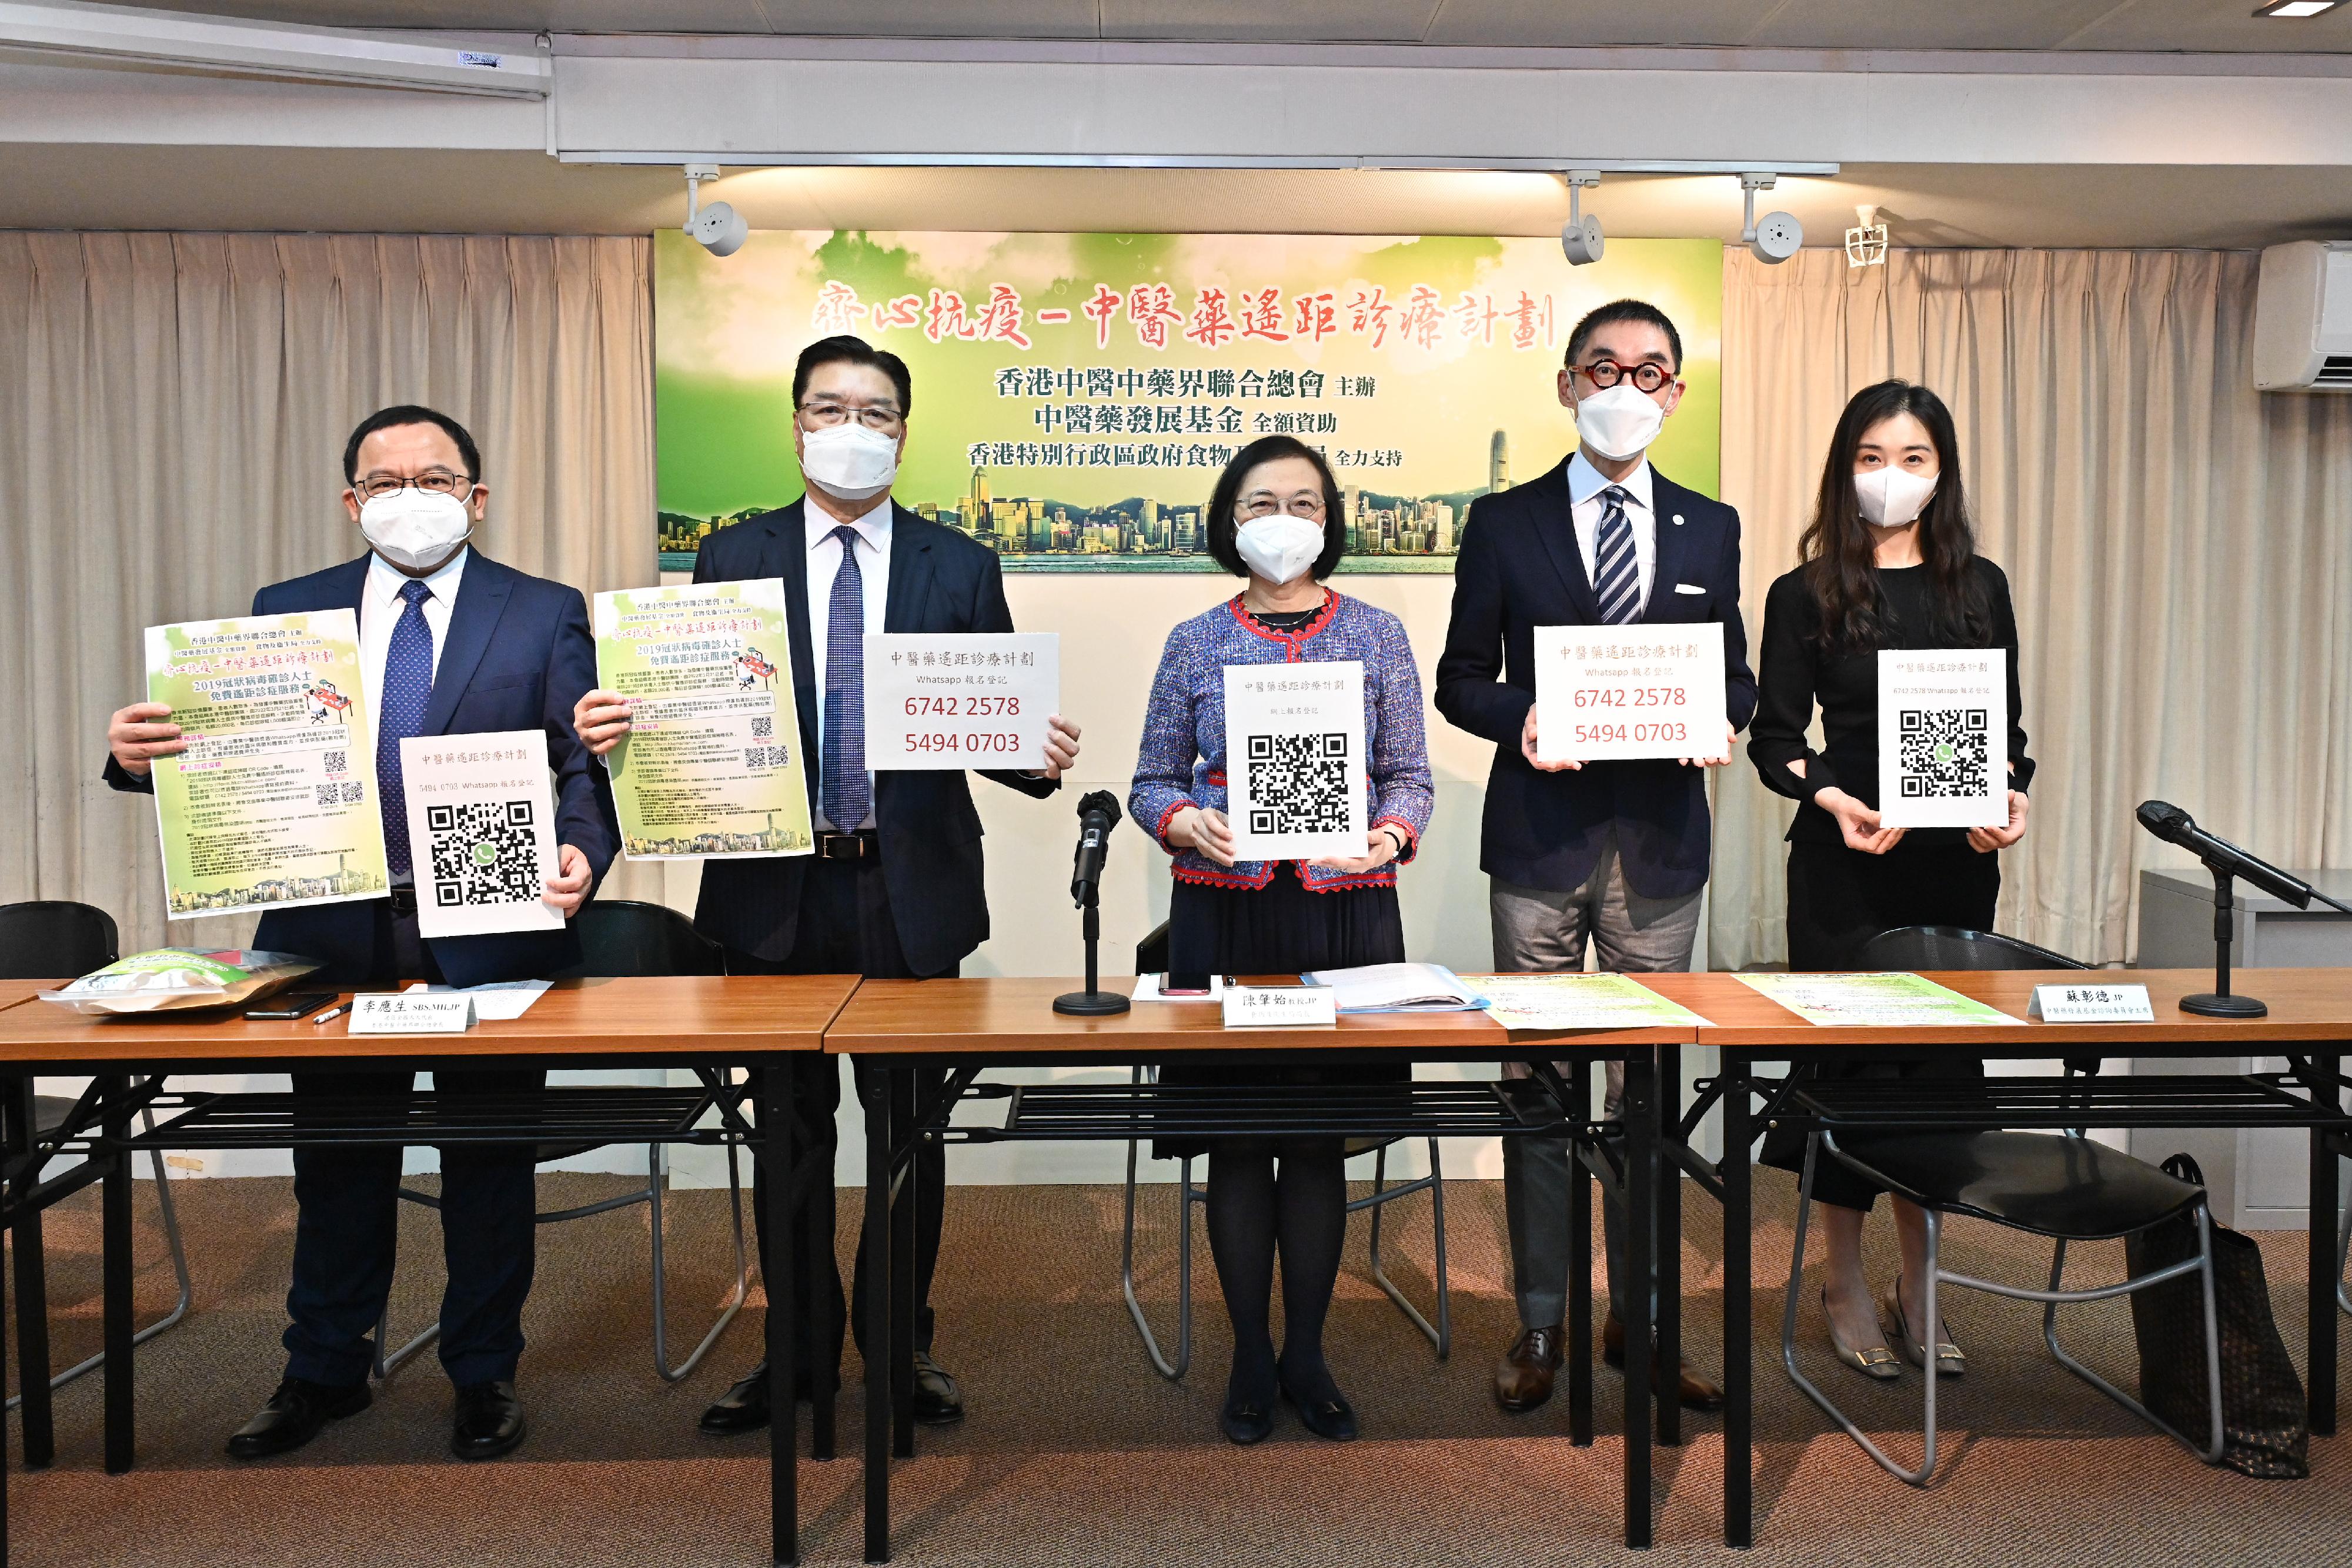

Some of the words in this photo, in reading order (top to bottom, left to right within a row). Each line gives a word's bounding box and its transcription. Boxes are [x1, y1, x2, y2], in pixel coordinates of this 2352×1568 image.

[995, 368, 1325, 398] 香港中醫中藥界聯合總會
[1334, 376, 1375, 397] 主辦
[1035, 406, 1243, 434] 中醫藥發展基金
[1252, 412, 1337, 433] 全額資助
[1335, 449, 1402, 467] 全力支持
[891, 651, 1034, 667] 中醫藥遙距診療計劃
[1561, 644, 1698, 660] 中醫藥遙距診療計劃
[916, 676, 961, 685] Whatsapp
[964, 675, 1007, 684] 報名登記
[1585, 668, 1628, 677] Whatsapp
[1631, 667, 1673, 676] 報名登記
[1244, 680, 1344, 693] 中醫藥遙距診療計劃
[1575, 690, 1626, 707] 6742
[1634, 688, 1686, 706] 2578
[905, 697, 958, 716] 6742
[966, 697, 1020, 716] 2578
[1575, 724, 1627, 743] 5494
[1635, 723, 1686, 741] 0703
[905, 733, 959, 752] 5494
[966, 733, 1020, 752] 0703
[422, 749, 527, 765] 中醫藥遙距診療計劃
[419, 784, 437, 793] 5494
[440, 783, 458, 791] 0703
[2066, 990, 2110, 1003] 蘇彰德
[363, 1000, 407, 1014] 李應生
